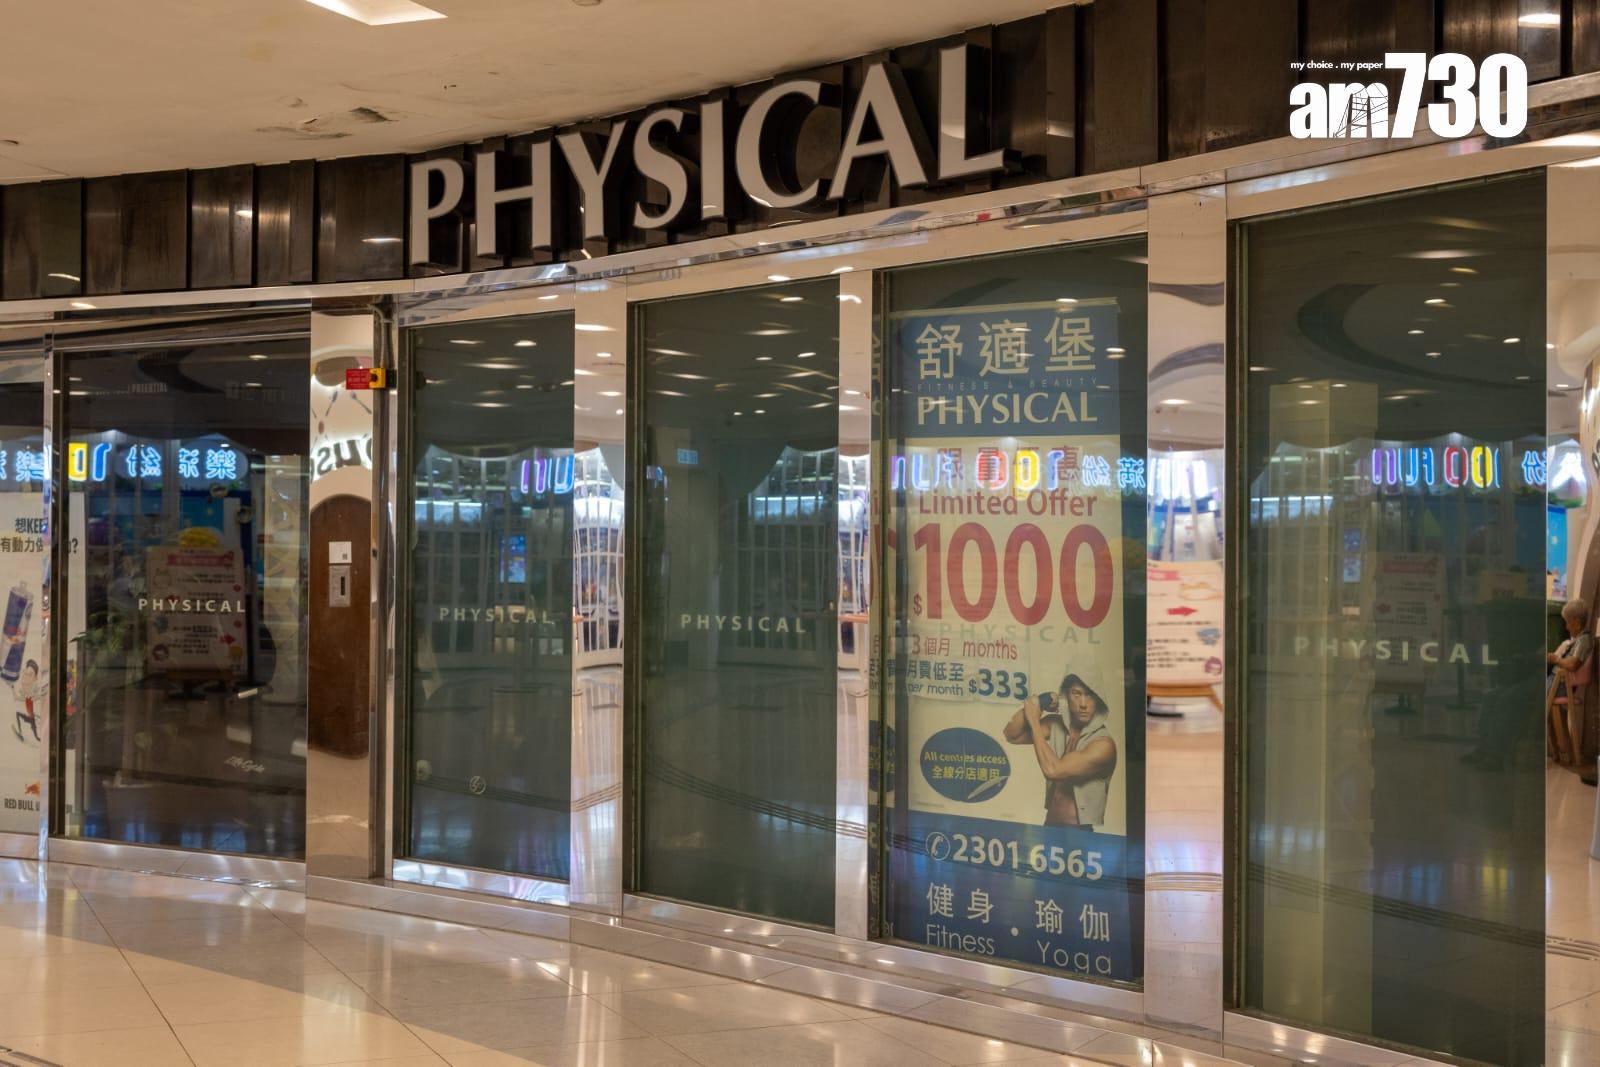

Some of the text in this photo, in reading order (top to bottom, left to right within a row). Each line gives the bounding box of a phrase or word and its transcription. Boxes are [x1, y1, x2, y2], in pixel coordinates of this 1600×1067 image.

[409, 42, 1005, 265] PHYSICAL
[916, 317, 1096, 380] 舒適堡
[917, 390, 1098, 425] PHYSICAL
[919, 488, 1098, 516] Limited Offer
[138, 598, 246, 613] PHYSICAL
[439, 607, 556, 626] PHYSICAL
[680, 614, 806, 633] PHYSICAL
[963, 637, 1018, 661] months
[1294, 637, 1499, 665] PHYSICAL
[927, 682, 964, 697] month
[968, 668, 1029, 701] $333
[924, 751, 938, 762] All
[976, 755, 1008, 765] access
[4, 798, 17, 809] RED
[18, 799, 34, 811] BULL
[953, 832, 1103, 881] 2301 6565
[926, 882, 995, 924] 健身
[1035, 899, 1110, 943] 瑜伽
[926, 923, 1112, 976] Fitness Yoga
